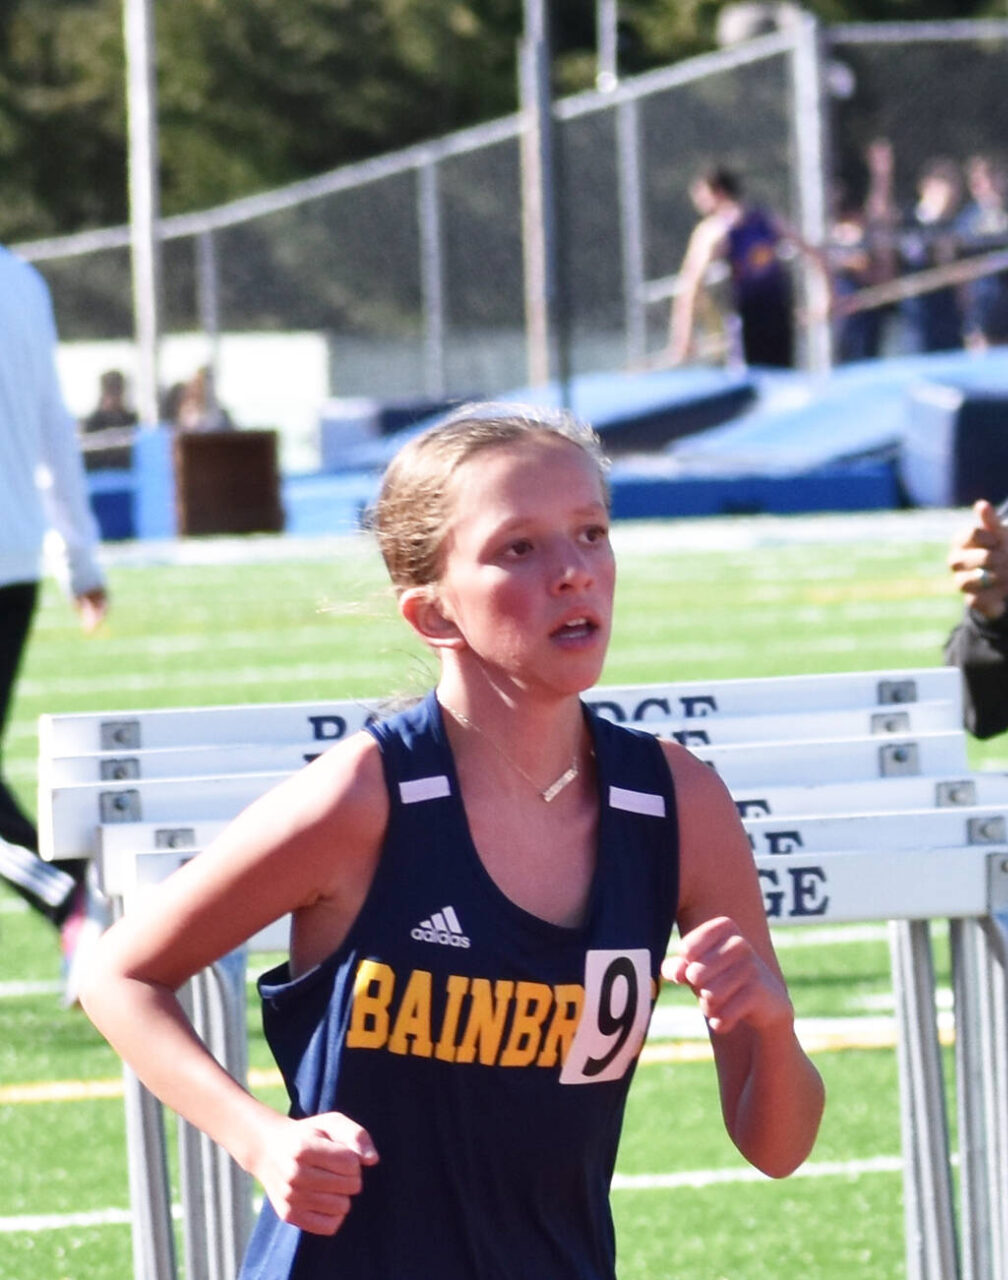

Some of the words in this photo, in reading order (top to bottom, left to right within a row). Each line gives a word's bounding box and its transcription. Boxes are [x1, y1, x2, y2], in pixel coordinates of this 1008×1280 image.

[411, 928, 471, 949] adidas
[347, 959, 585, 1067] BAINBR
[582, 957, 638, 1077] 9
